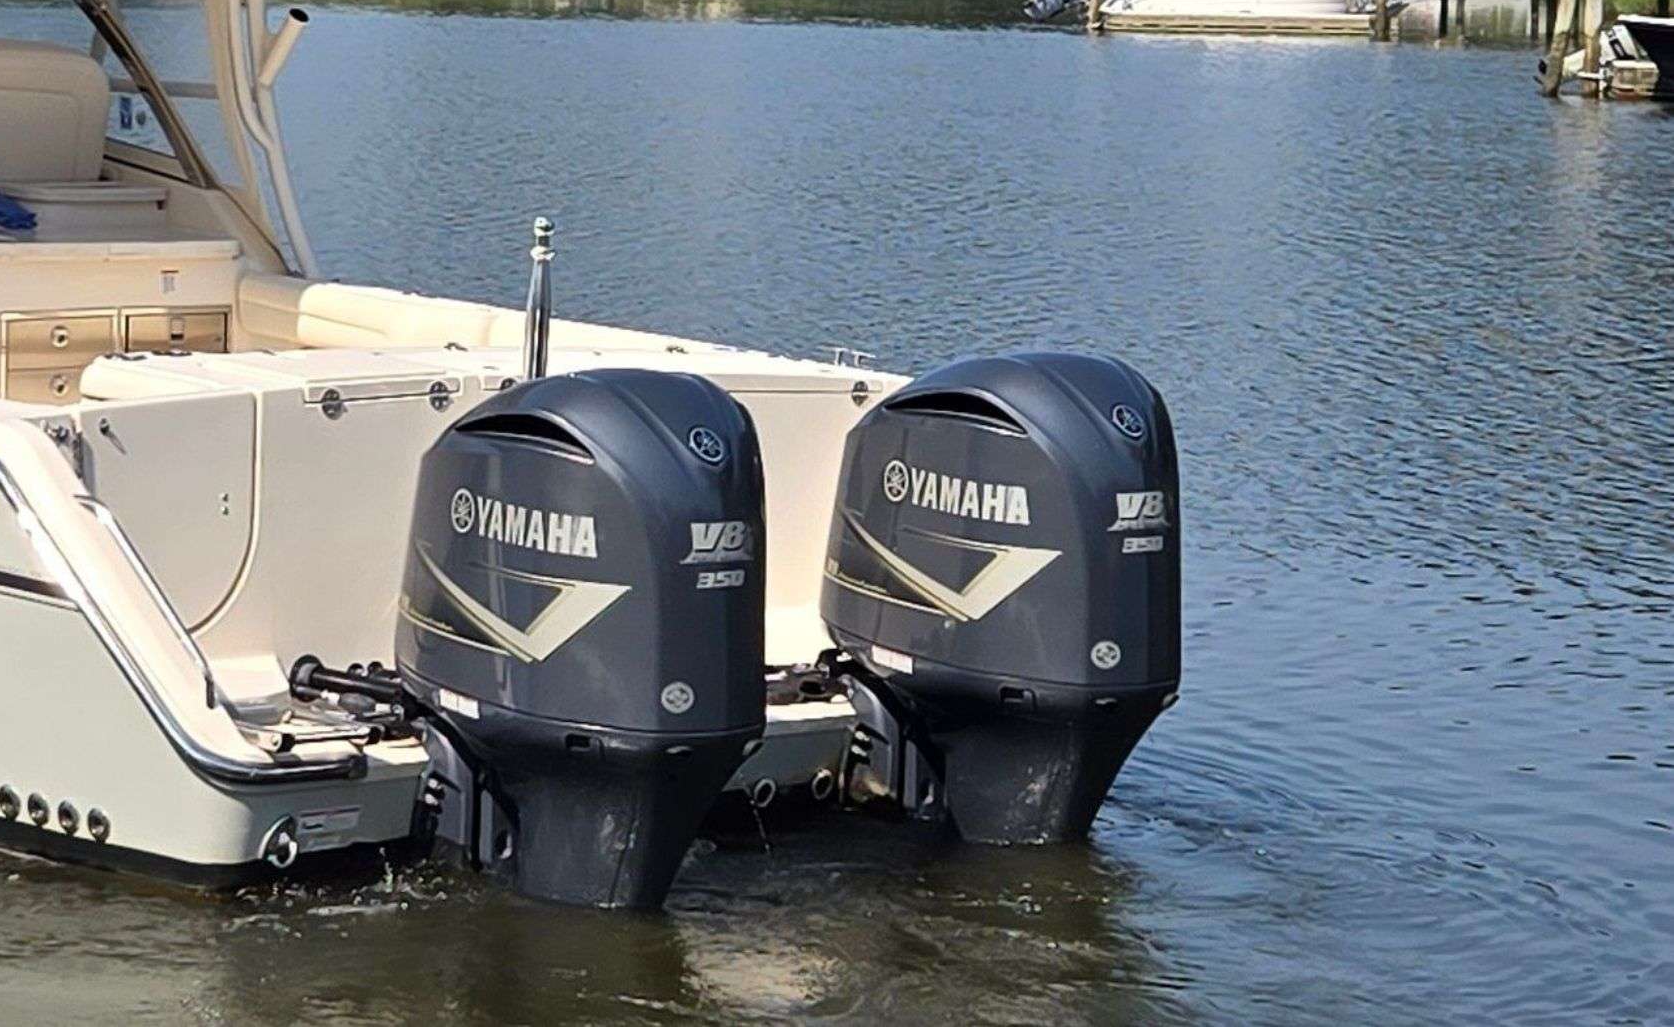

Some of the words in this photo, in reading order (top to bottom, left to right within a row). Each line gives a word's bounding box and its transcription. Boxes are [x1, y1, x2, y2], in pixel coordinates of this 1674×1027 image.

[910, 467, 1031, 526] YAMAHA
[1116, 491, 1164, 521] V8
[476, 495, 598, 558] YAMAHA
[690, 521, 746, 552] V8
[696, 570, 746, 590] 350
